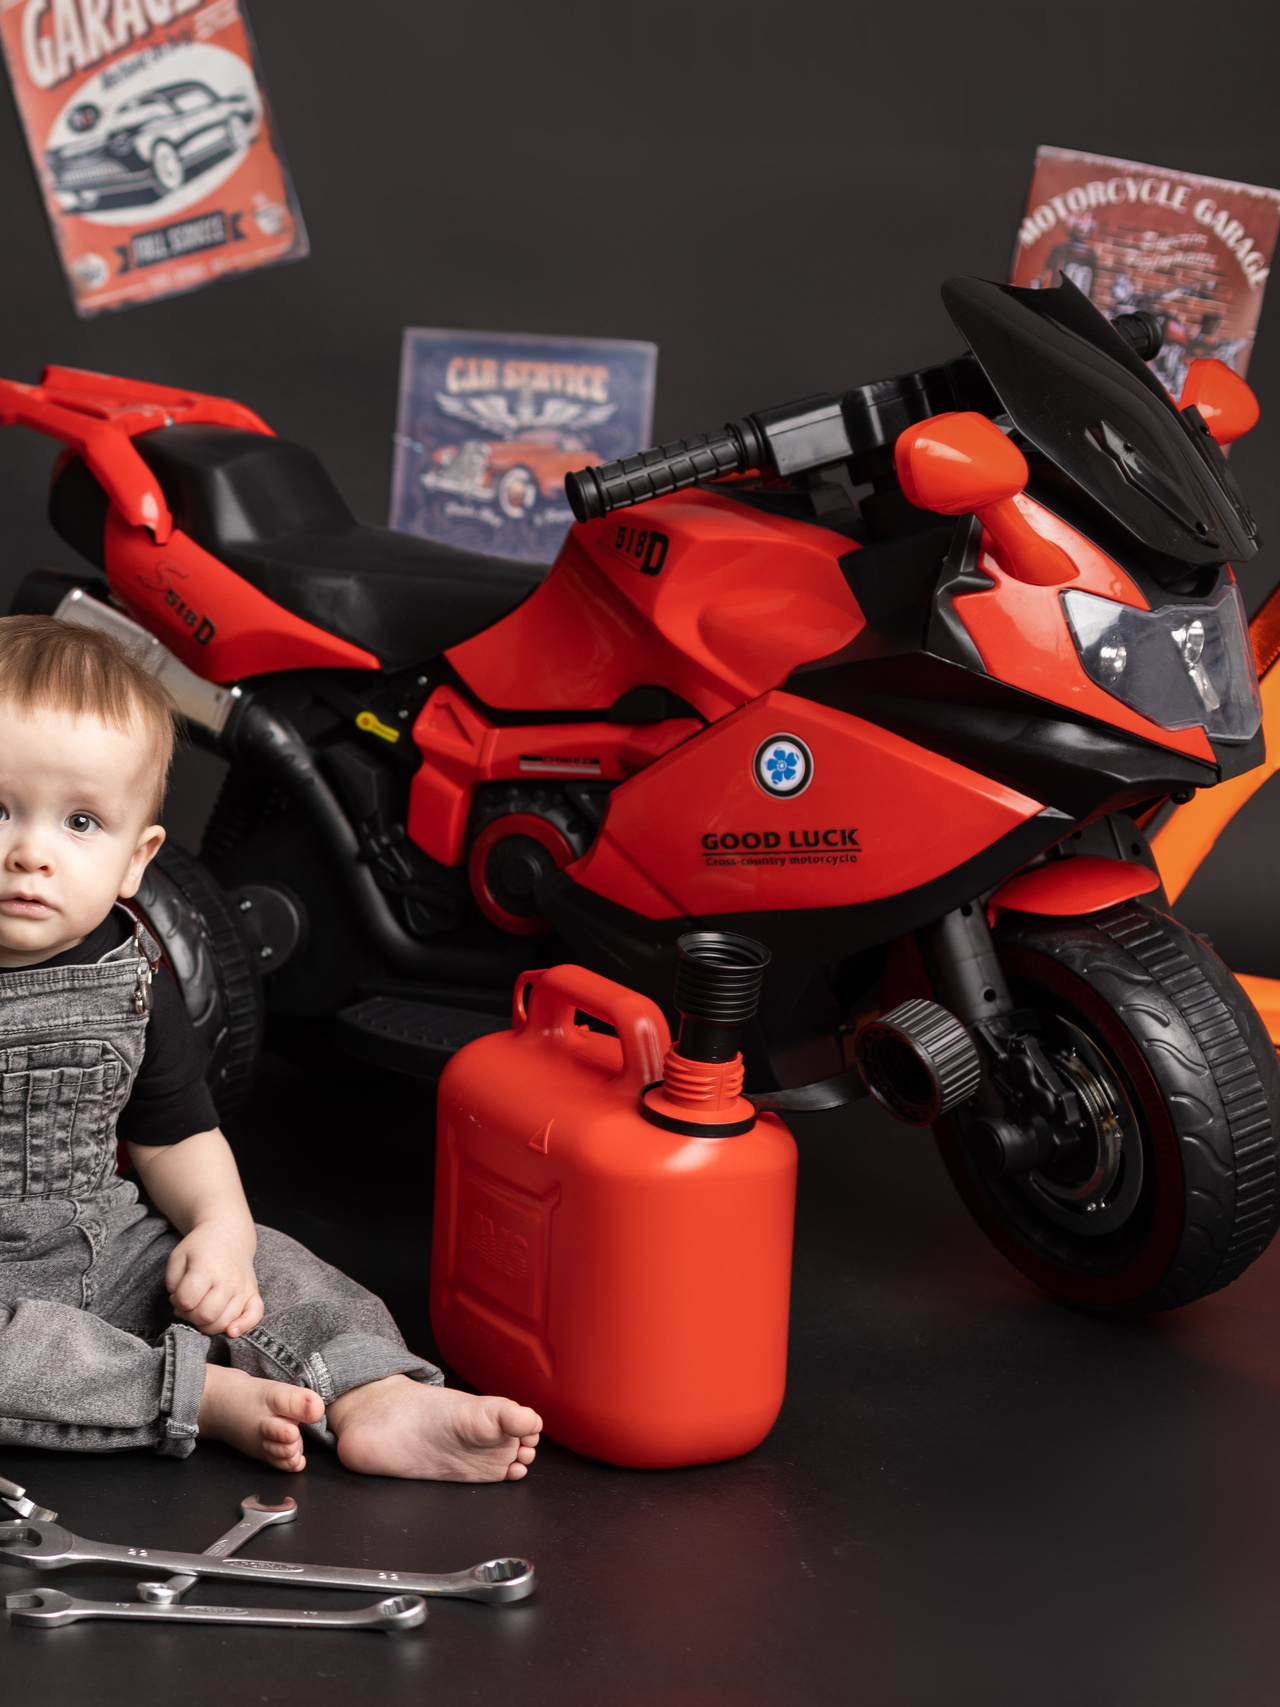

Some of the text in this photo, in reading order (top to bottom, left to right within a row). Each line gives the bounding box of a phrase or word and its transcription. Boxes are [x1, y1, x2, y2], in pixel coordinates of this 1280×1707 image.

[22, 0, 206, 89] GARA
[446, 356, 498, 394] CAR
[701, 829, 859, 850] GOOD LUCK
[705, 853, 857, 867] Cross-country motorcycle
[127, 1548, 148, 1557] 22
[378, 1572, 399, 1581] 22
